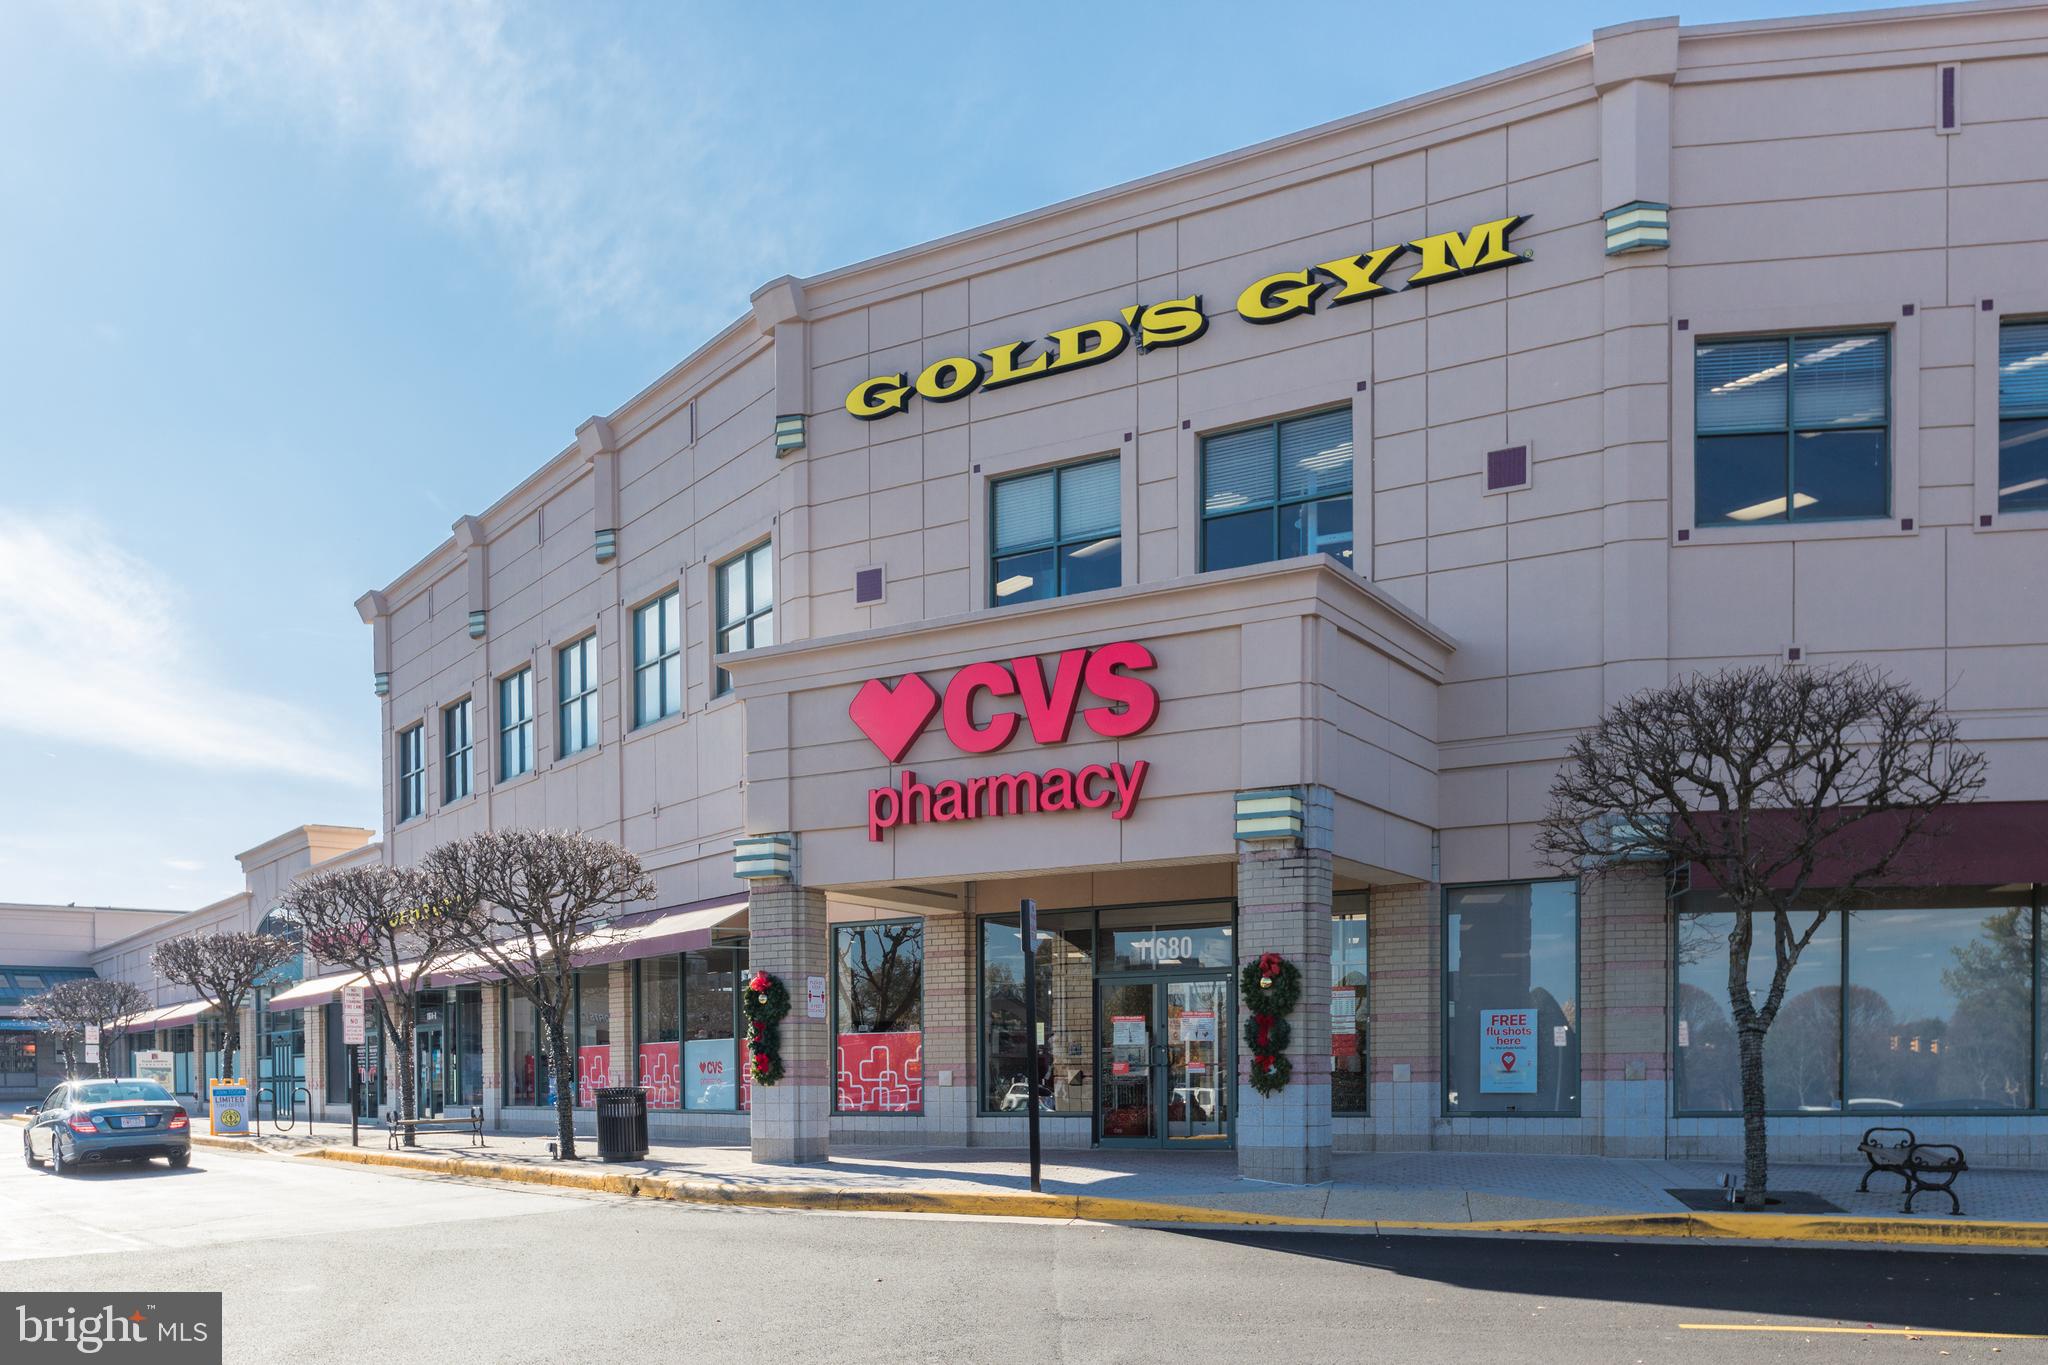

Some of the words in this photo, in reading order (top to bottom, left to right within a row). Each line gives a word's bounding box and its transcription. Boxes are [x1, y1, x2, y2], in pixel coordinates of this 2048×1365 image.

[845, 293, 1208, 420] GOLD'S
[1236, 213, 1531, 323] GYM
[943, 641, 1160, 754] CVS
[867, 760, 1150, 843] pharmacy
[1141, 936, 1193, 960] 11680
[1491, 1014, 1527, 1026] FREE
[1486, 1027, 1500, 1036] flu
[1502, 1027, 1532, 1036] shots
[1496, 1036, 1521, 1045] here
[706, 1060, 723, 1074] CVS
